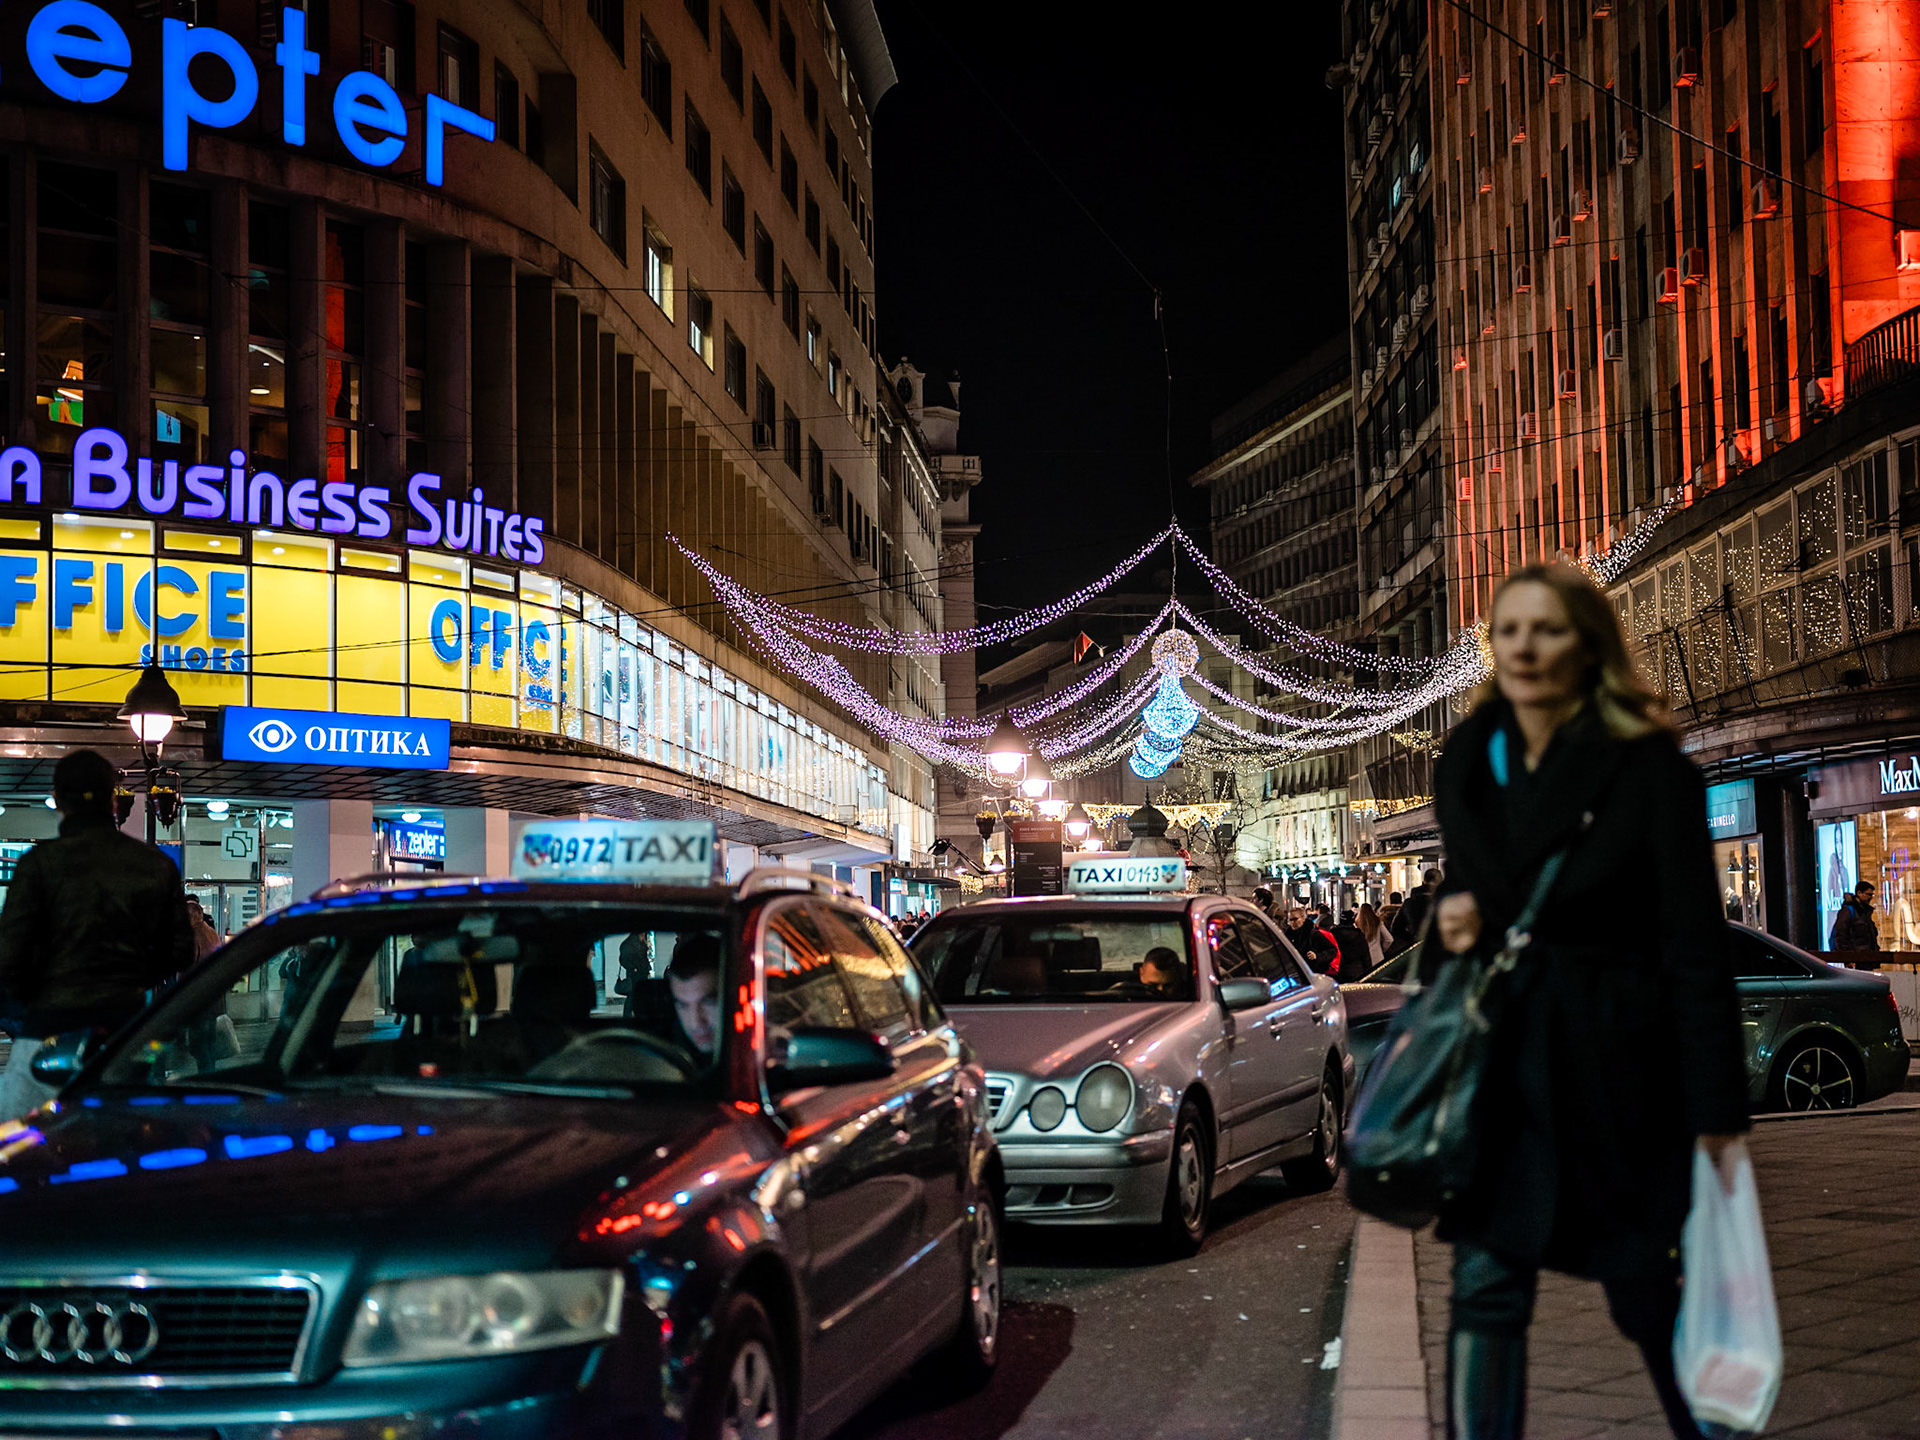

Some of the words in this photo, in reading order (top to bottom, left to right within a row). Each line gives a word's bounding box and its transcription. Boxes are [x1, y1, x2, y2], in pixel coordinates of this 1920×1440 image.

[304, 726, 431, 757] ОПТИКА
[407, 829, 439, 858] zepter
[550, 836, 612, 864] 0972
[619, 836, 707, 863] TAXI
[1073, 867, 1123, 883] TAXI
